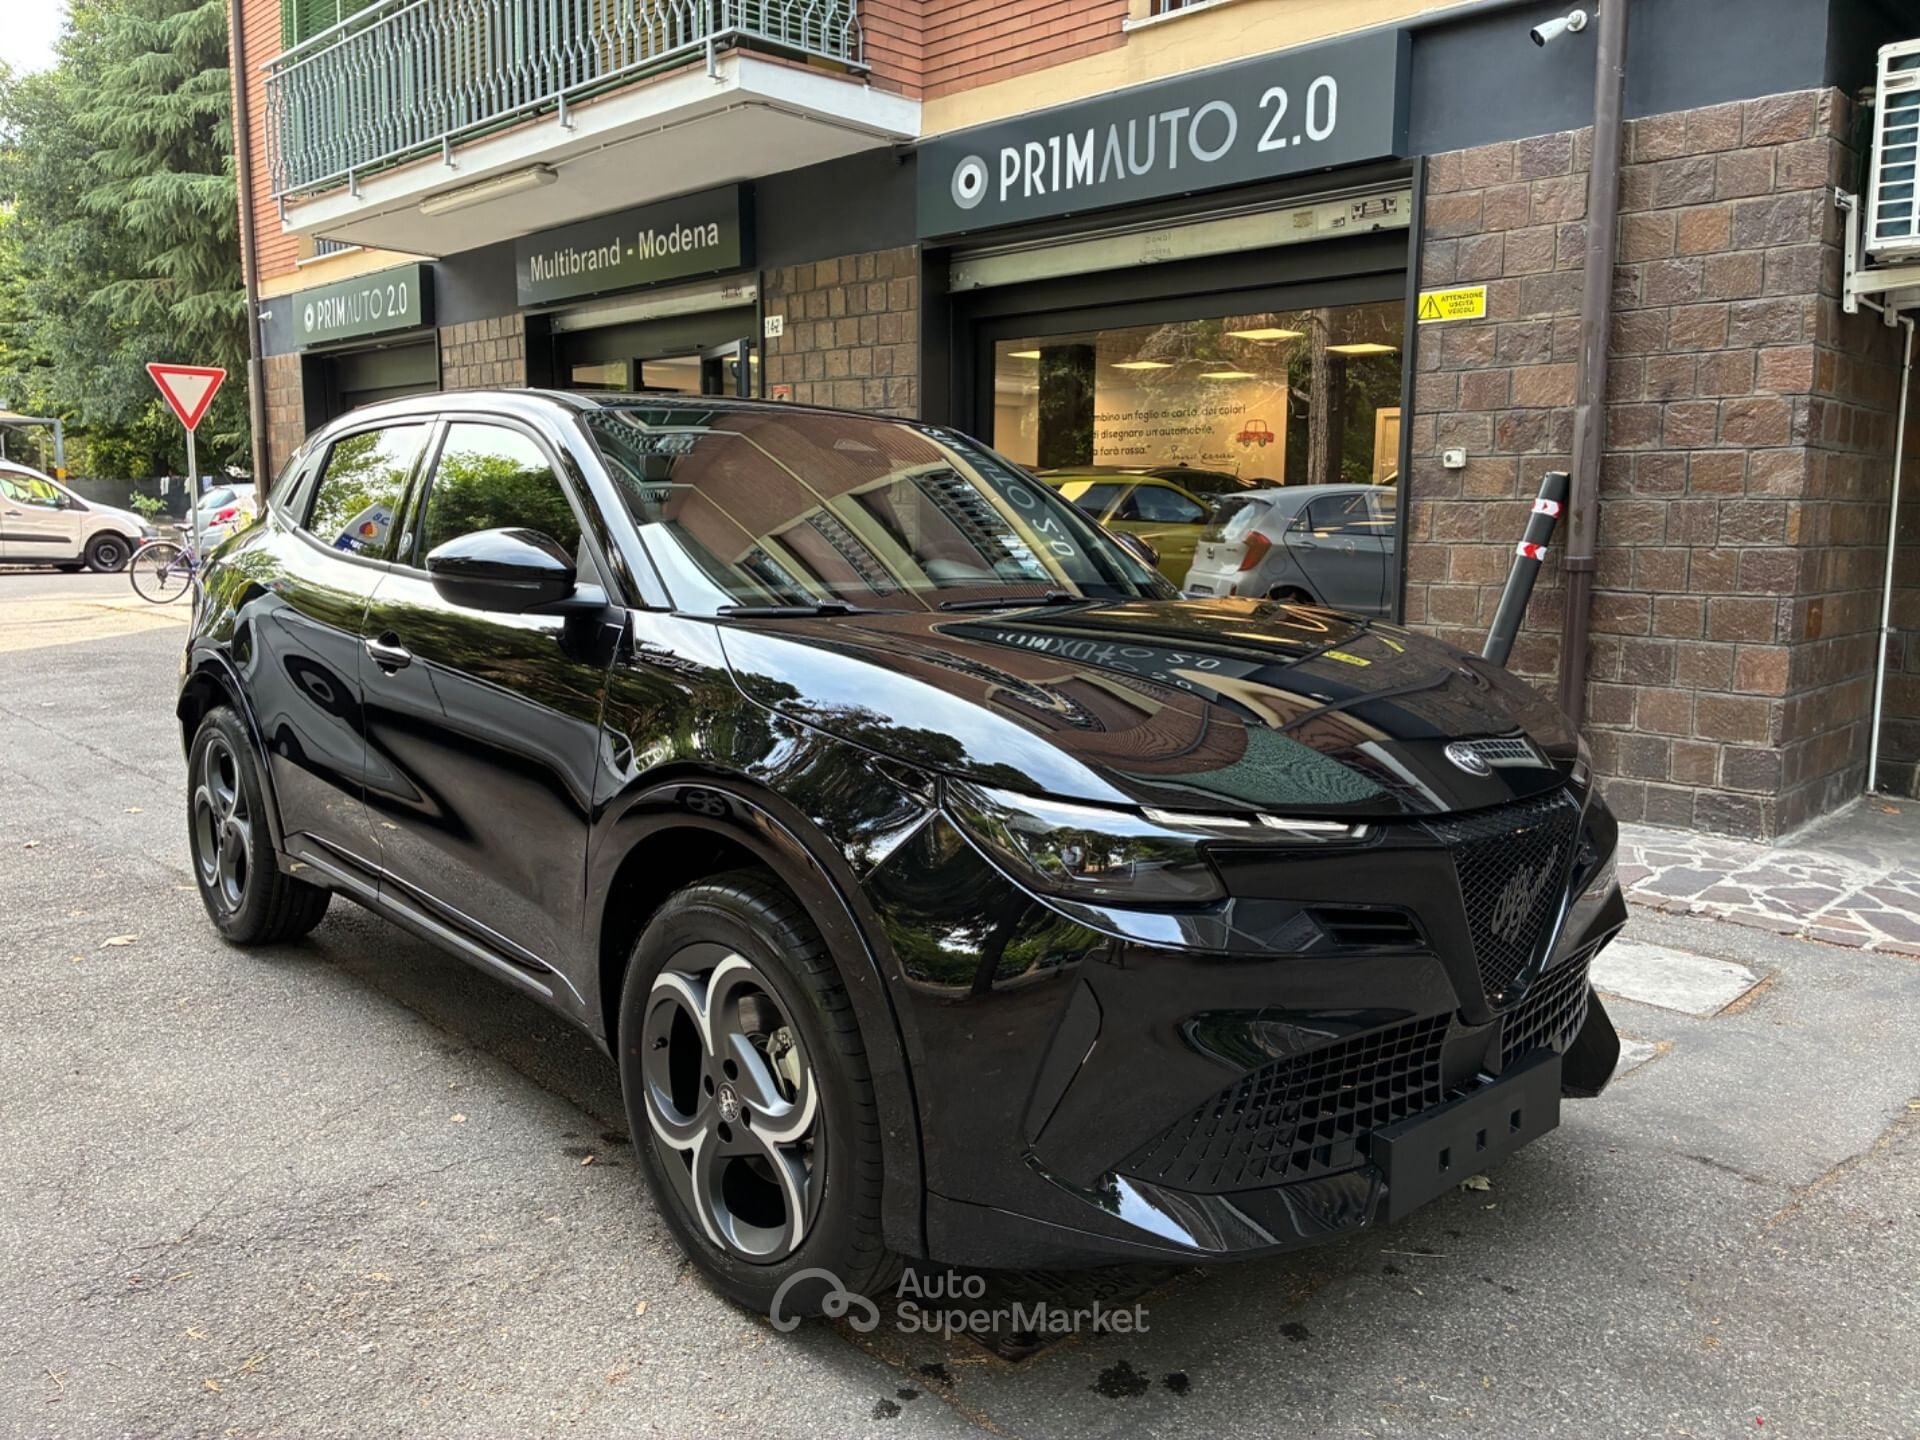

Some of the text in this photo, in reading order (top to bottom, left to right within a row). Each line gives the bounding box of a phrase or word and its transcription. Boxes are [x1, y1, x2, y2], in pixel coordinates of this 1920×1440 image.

[1257, 75, 1337, 152] 2.0
[530, 237, 621, 282] Multibrand
[638, 222, 719, 260] Modena
[387, 282, 407, 317] 2.0
[1441, 291, 1484, 302] ATTENZIONE
[1121, 412, 1133, 420] un
[1134, 409, 1160, 423] foglio
[1219, 404, 1246, 415] colori
[1101, 429, 1144, 441] disegnare
